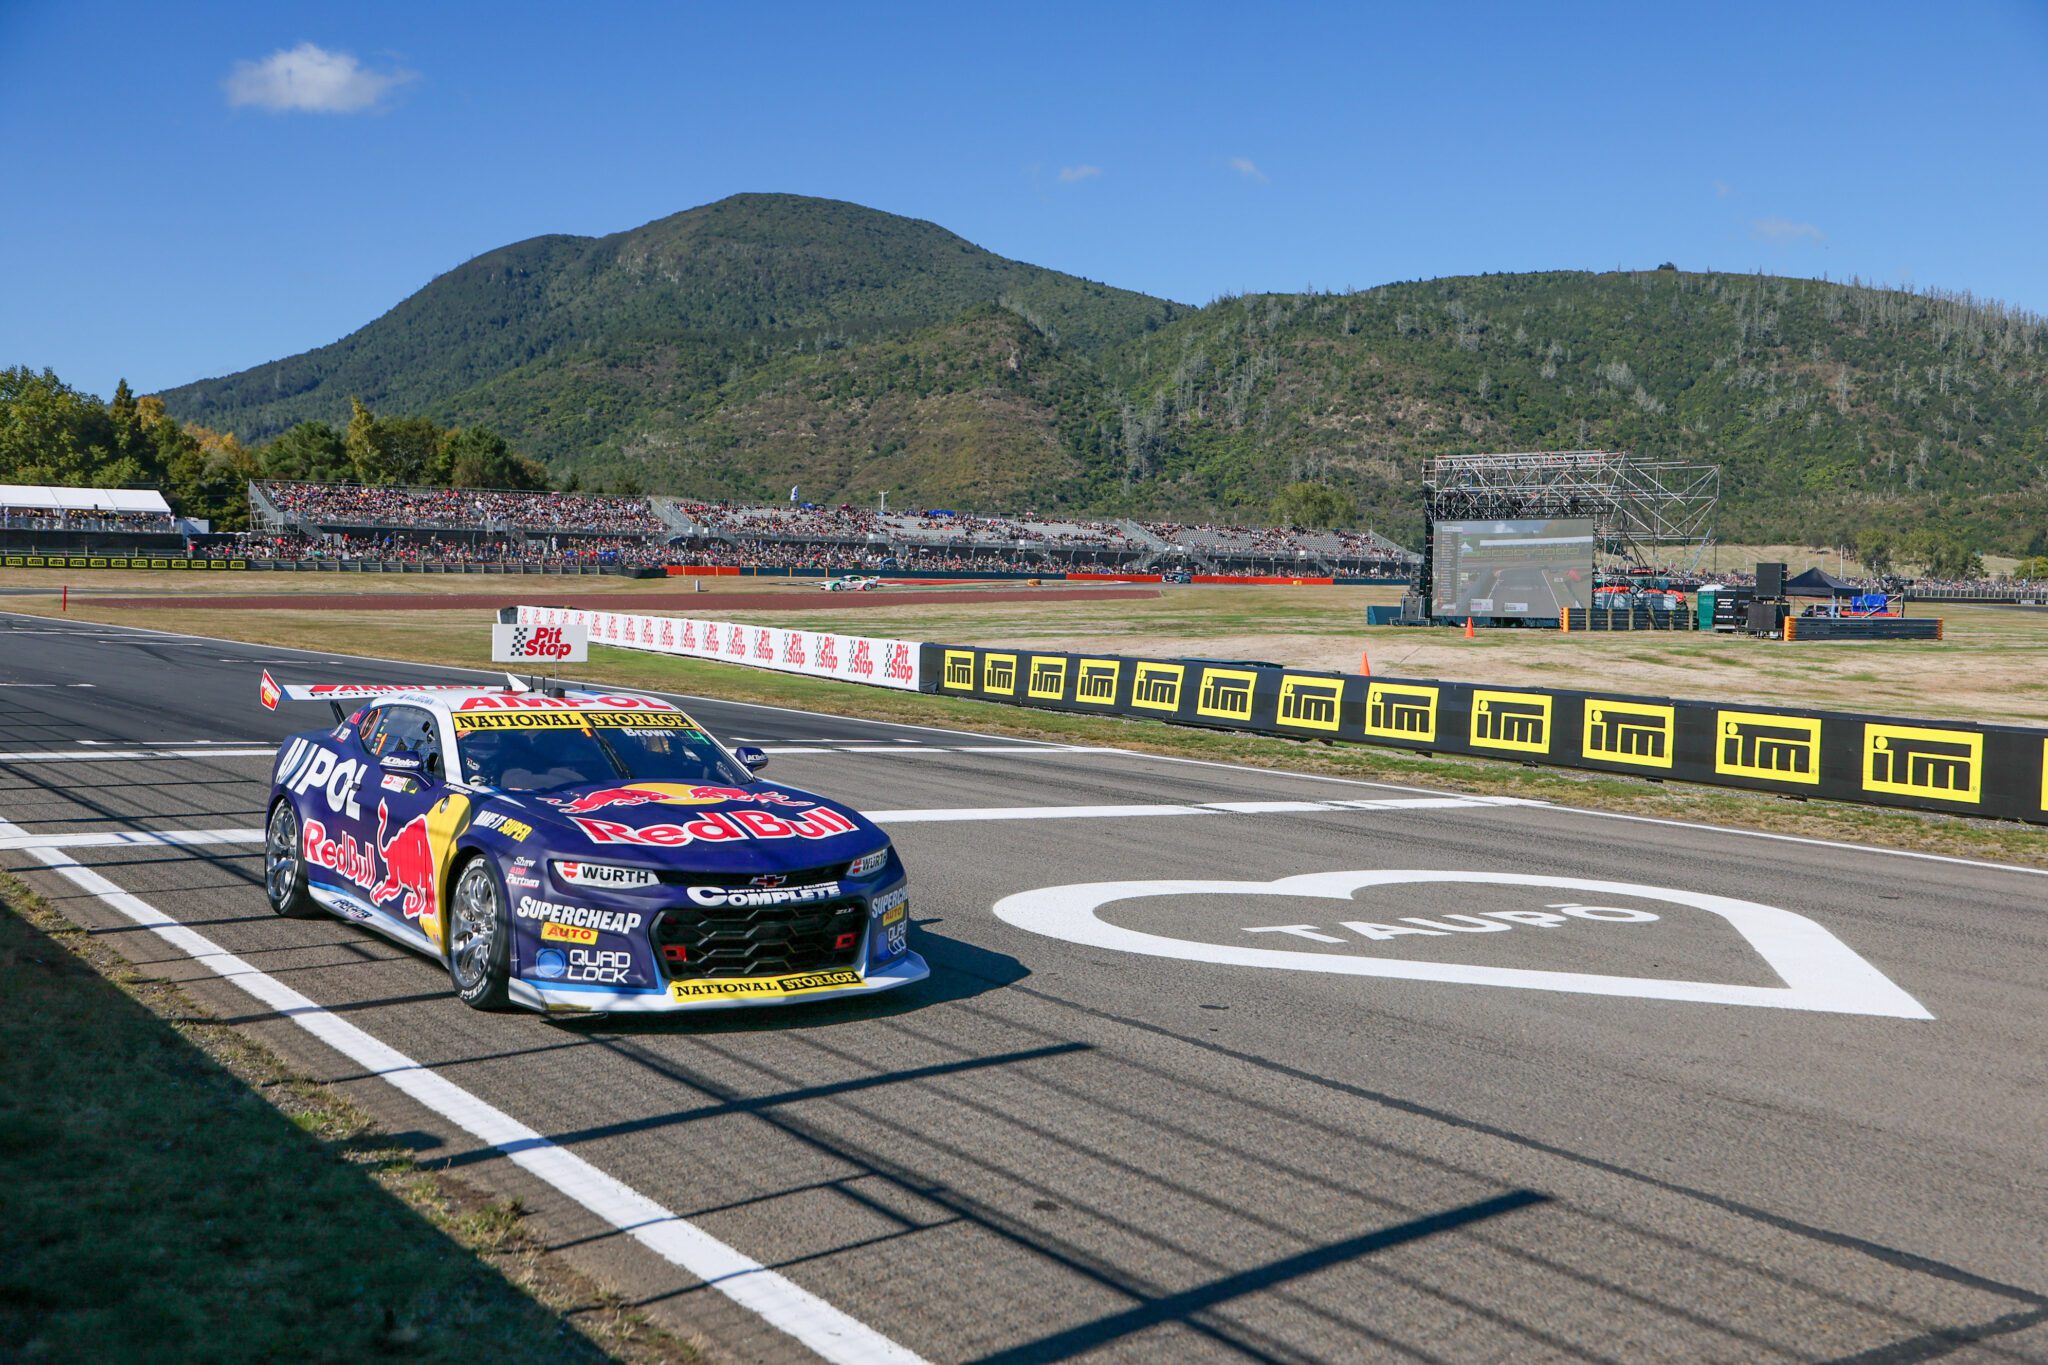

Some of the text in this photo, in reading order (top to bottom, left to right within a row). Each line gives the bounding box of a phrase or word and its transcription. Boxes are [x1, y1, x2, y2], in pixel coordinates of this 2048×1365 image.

[534, 627, 563, 643] Pit
[708, 624, 718, 639] Pit
[733, 626, 743, 642] Pit
[760, 629, 771, 647] Pit
[524, 639, 572, 659] Stop
[706, 638, 719, 654] Stop
[730, 640, 746, 659] Stop
[791, 632, 802, 650] Pit
[823, 636, 835, 655] Pit
[857, 639, 870, 659] Pit
[757, 644, 773, 662] Stop
[787, 648, 805, 668] Stop
[820, 651, 838, 673] Stop
[894, 643, 909, 663] Pit
[853, 655, 873, 677] Stop
[890, 659, 913, 684] Stop
[459, 695, 673, 711] AMPOL
[455, 712, 690, 729] NATIONAL STORAGE
[622, 727, 677, 738] Brown
[497, 818, 533, 843] SUPER
[513, 857, 536, 867] Shaw
[506, 873, 540, 888] Partners
[687, 884, 841, 907] COMPLETE
[516, 896, 642, 935] SUPERCHEAP
[884, 908, 902, 921] AUTO
[547, 926, 592, 940] AUTO
[569, 949, 631, 968] QUAD
[567, 967, 630, 984] LOCK
[676, 971, 858, 997] NATIONAL STORAGE
